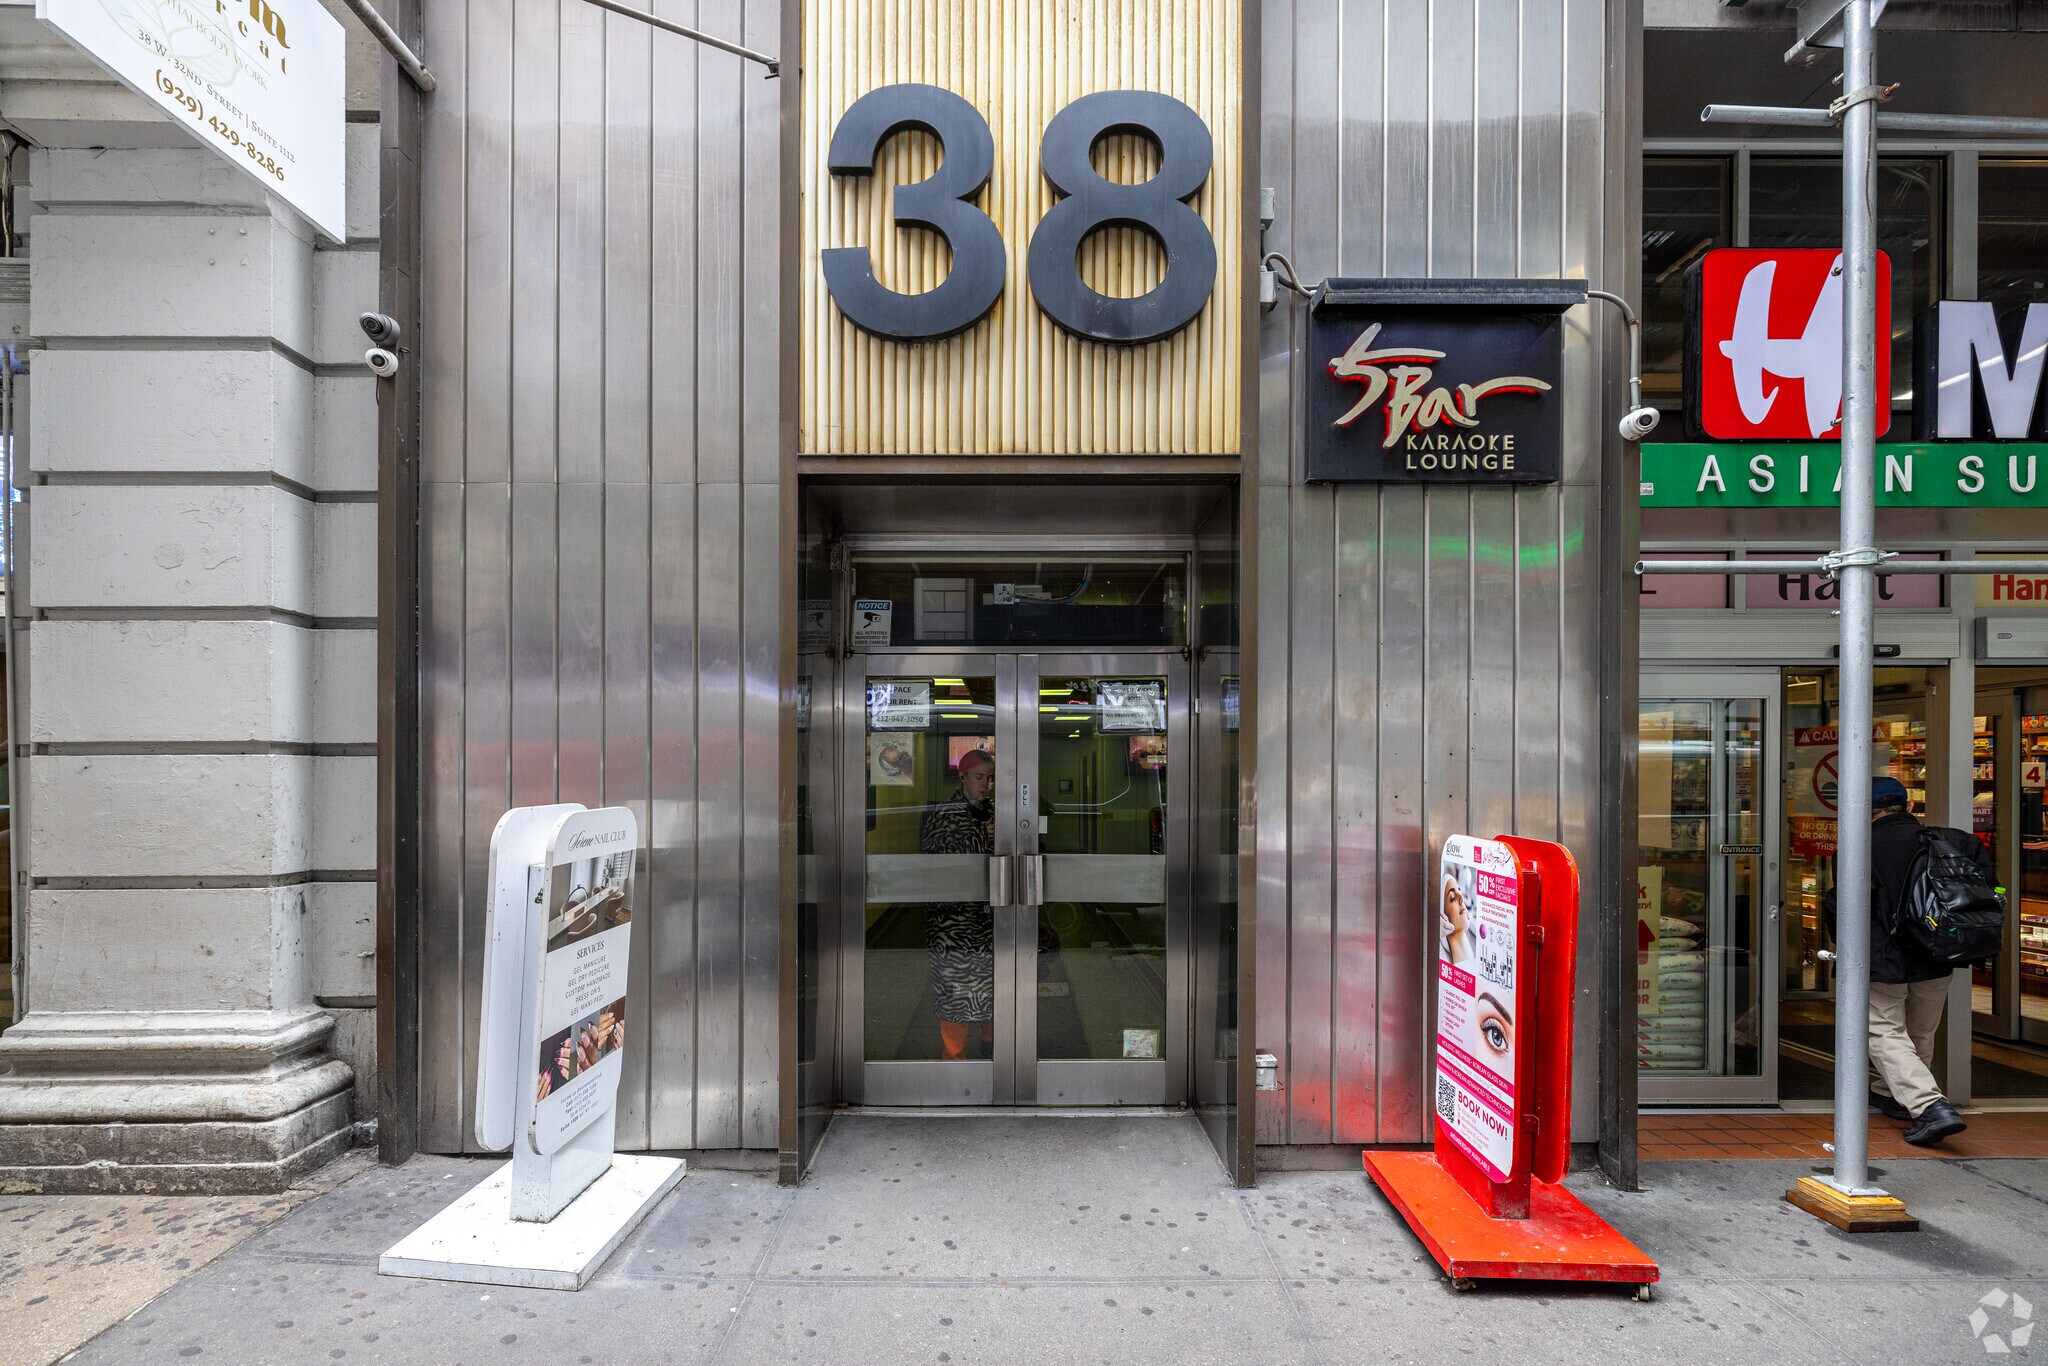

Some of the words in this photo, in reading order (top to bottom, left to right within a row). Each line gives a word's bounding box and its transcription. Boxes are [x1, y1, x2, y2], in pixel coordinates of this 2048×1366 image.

[138, 29, 152, 46] 38
[196, 19, 231, 56] BODY
[233, 51, 268, 91] WORK
[155, 68, 204, 121] (929)
[207, 115, 286, 182] 429-8286
[821, 82, 1218, 346] 38
[1382, 365, 1553, 450] Bar
[1406, 433, 1515, 452] KARAOKE
[1405, 454, 1515, 471] LOUNGE
[1695, 453, 1913, 494] ASIN
[1778, 574, 1895, 601] Hat
[858, 602, 889, 610] NOTICE
[876, 715, 925, 723] 212-947-3050
[2026, 766, 2041, 783] 4
[567, 829, 594, 852] Serene
[594, 832, 610, 845] NAIL
[610, 830, 627, 842] CLUB
[1799, 831, 1812, 840] OR
[1722, 846, 1761, 854] ENTRANCE
[1816, 842, 1835, 851] THIS
[1495, 876, 1506, 885] FIRST
[576, 940, 605, 960] SERVICES
[573, 965, 582, 975] GEL
[583, 954, 607, 970] MANICURE
[564, 983, 586, 999] CUSTOM
[586, 971, 611, 988] HANDMADE
[567, 978, 577, 988] GEL
[588, 962, 610, 978] PEDICURE
[575, 991, 590, 1003] PRESS
[570, 1006, 579, 1017] GEL
[1472, 1060, 1487, 1076] KOREAN
[1486, 1071, 1499, 1085] GLASS
[1498, 1080, 1509, 1091] SKIN
[1457, 1090, 1481, 1119] BOOK
[1482, 1109, 1508, 1141] NOW!
